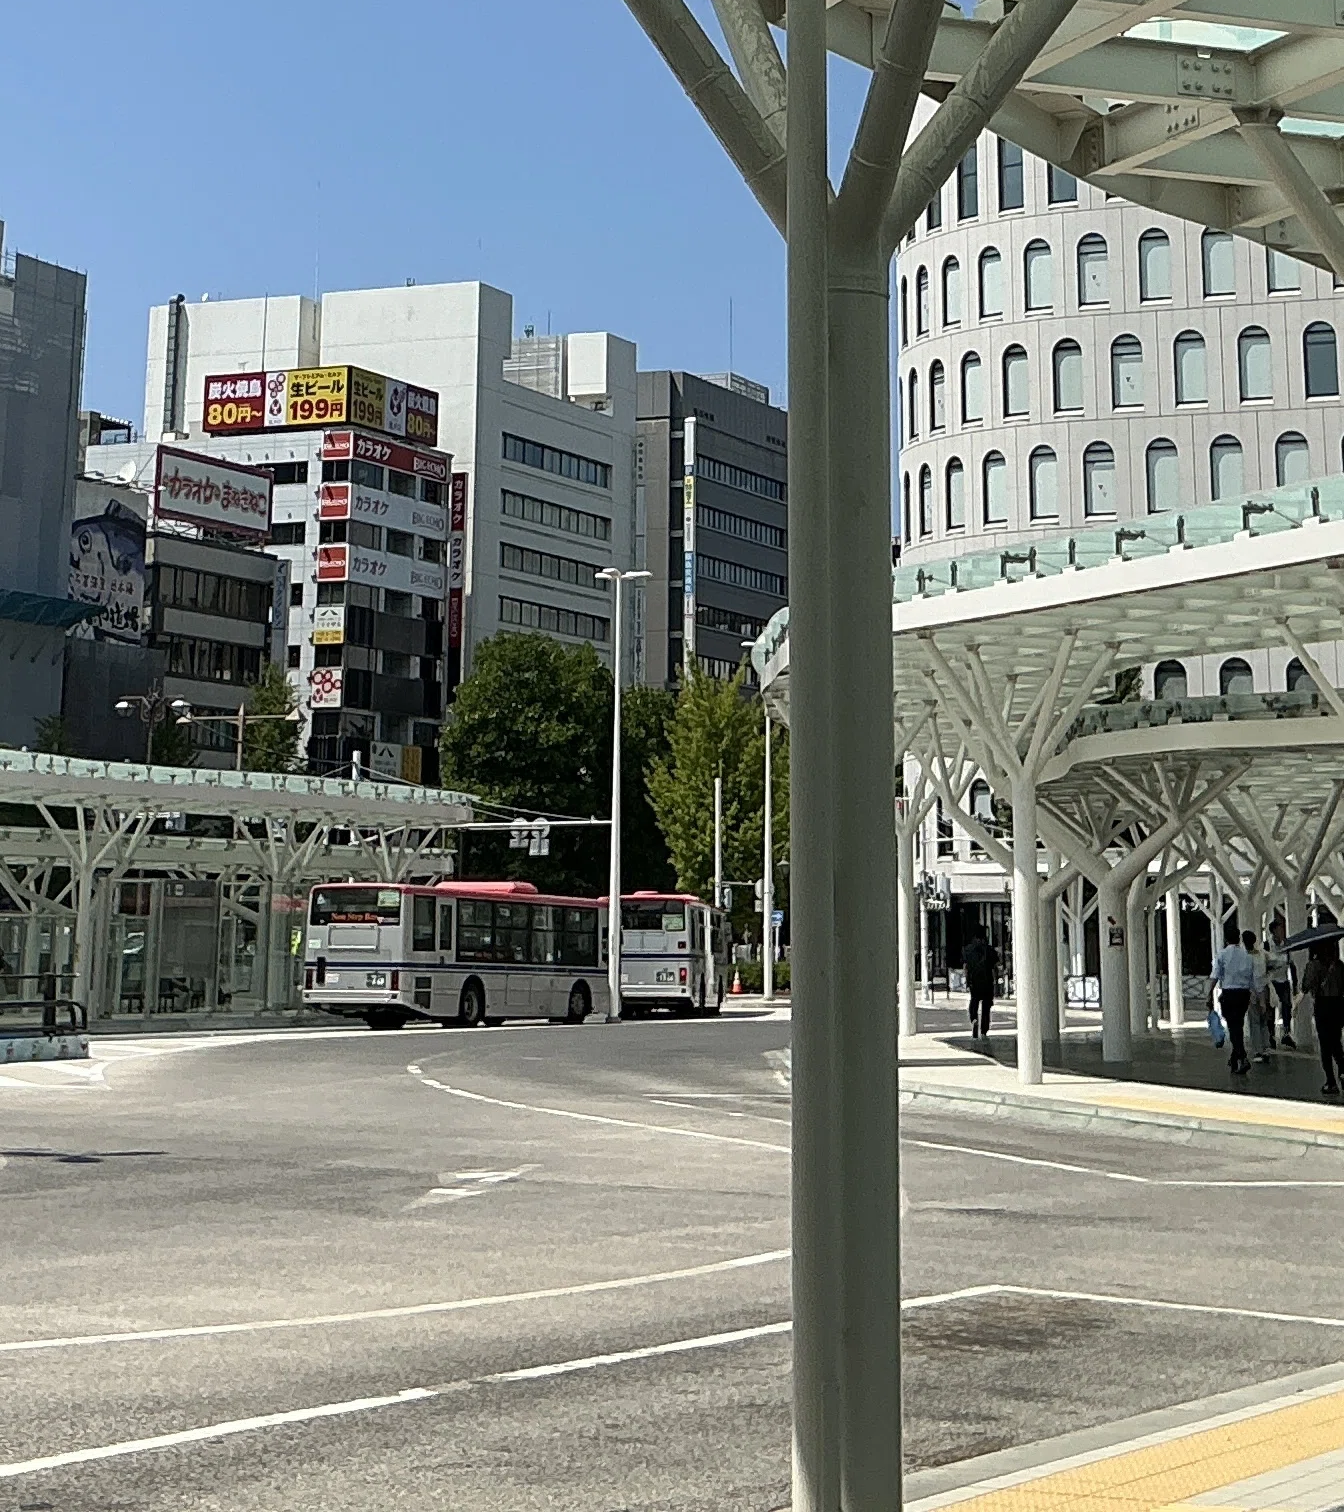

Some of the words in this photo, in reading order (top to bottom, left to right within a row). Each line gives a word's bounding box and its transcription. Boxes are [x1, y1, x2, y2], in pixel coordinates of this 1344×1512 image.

[208, 379, 262, 400] 炭火焼鳥
[290, 380, 345, 399] 生ビール
[289, 398, 343, 421] 199円
[353, 398, 384, 427] 199円
[355, 438, 392, 461] カラオケ
[355, 496, 390, 516] カラオケ
[452, 479, 464, 525] カラオケ
[353, 556, 388, 576] カラオケ
